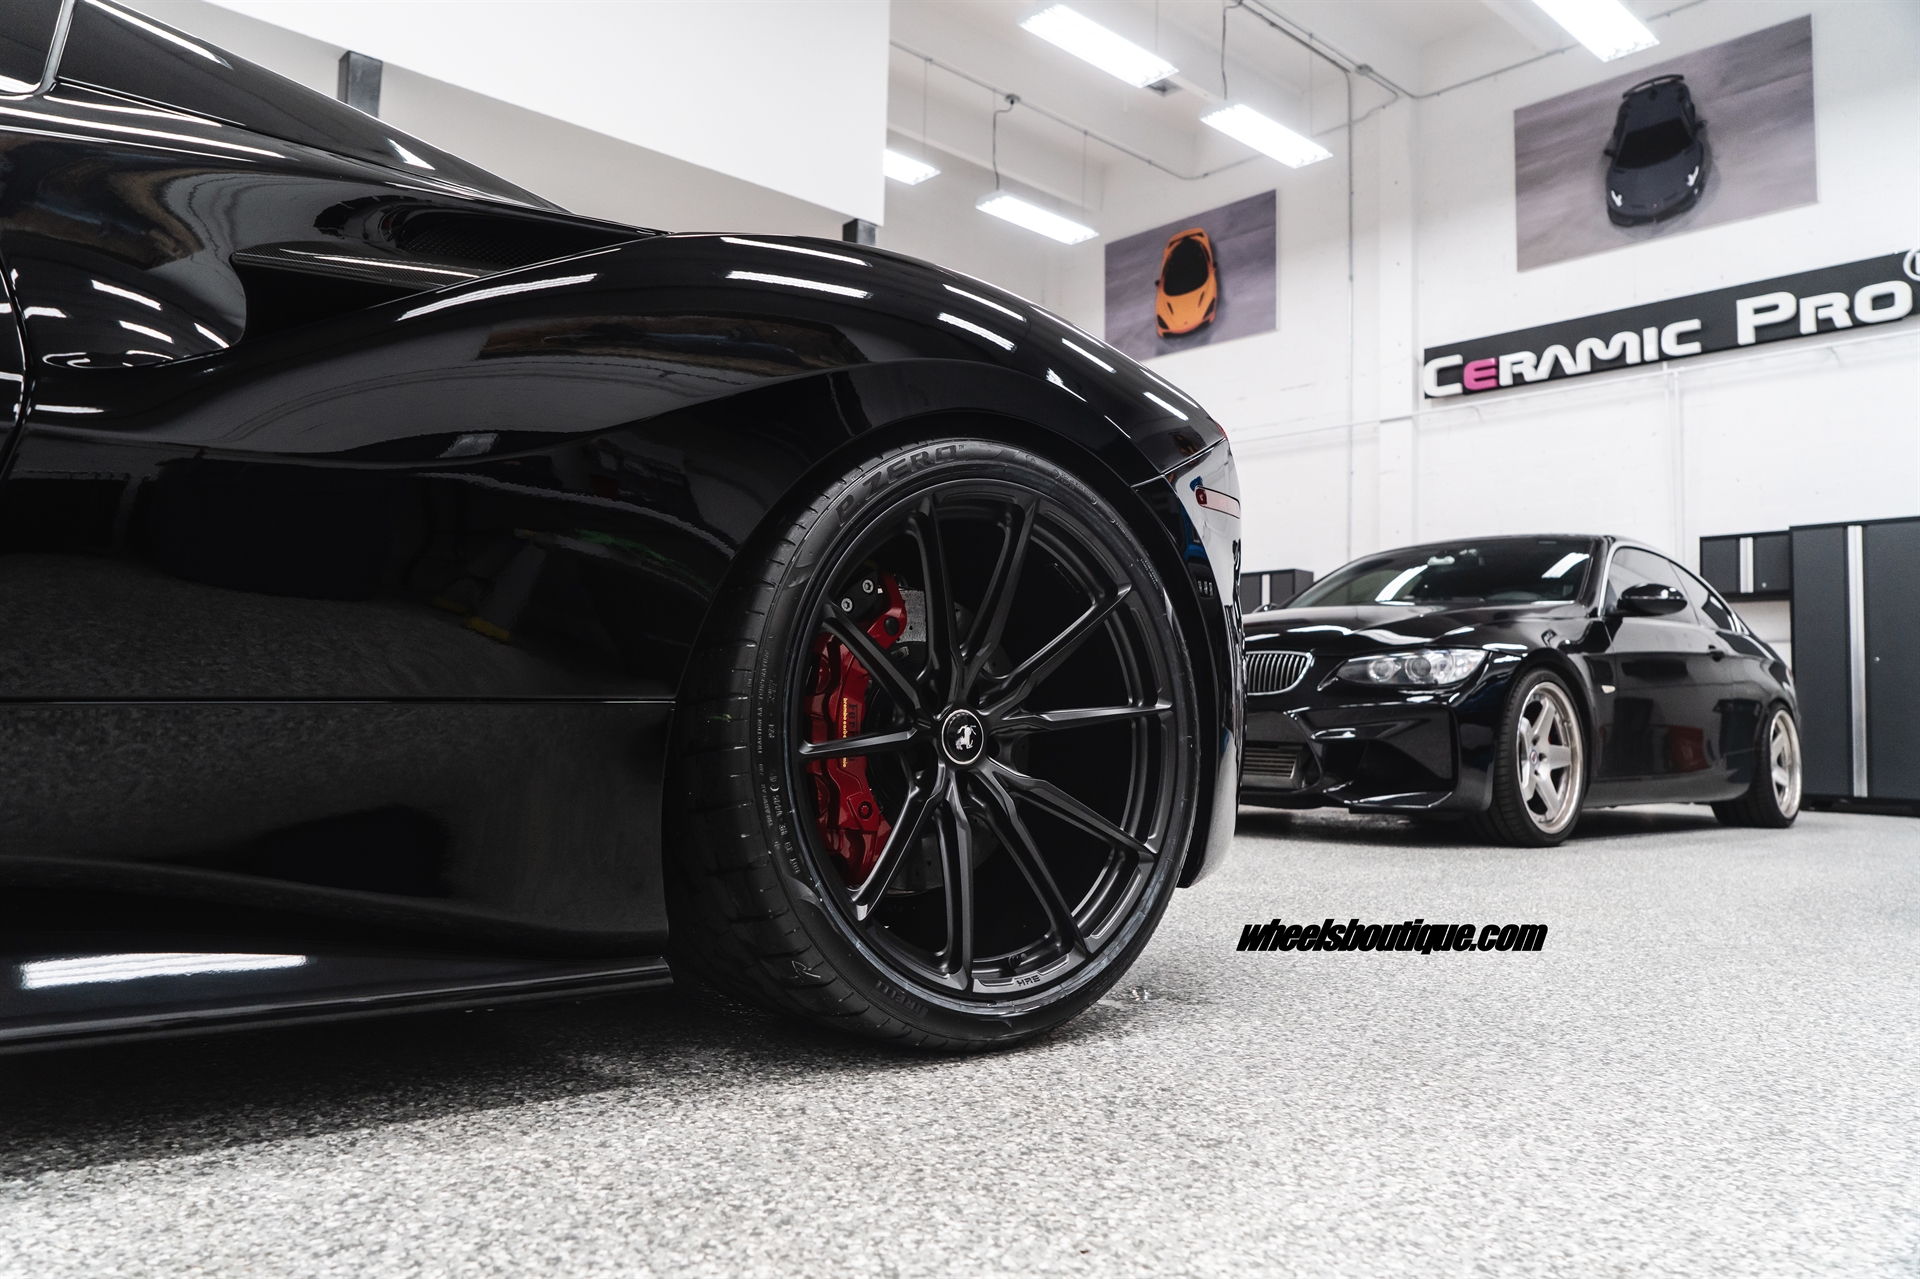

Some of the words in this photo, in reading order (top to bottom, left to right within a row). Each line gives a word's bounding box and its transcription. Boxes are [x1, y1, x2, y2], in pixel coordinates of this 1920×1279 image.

[835, 494, 855, 527] P
[862, 444, 957, 501] ZERO
[1016, 974, 1041, 987] HRE
